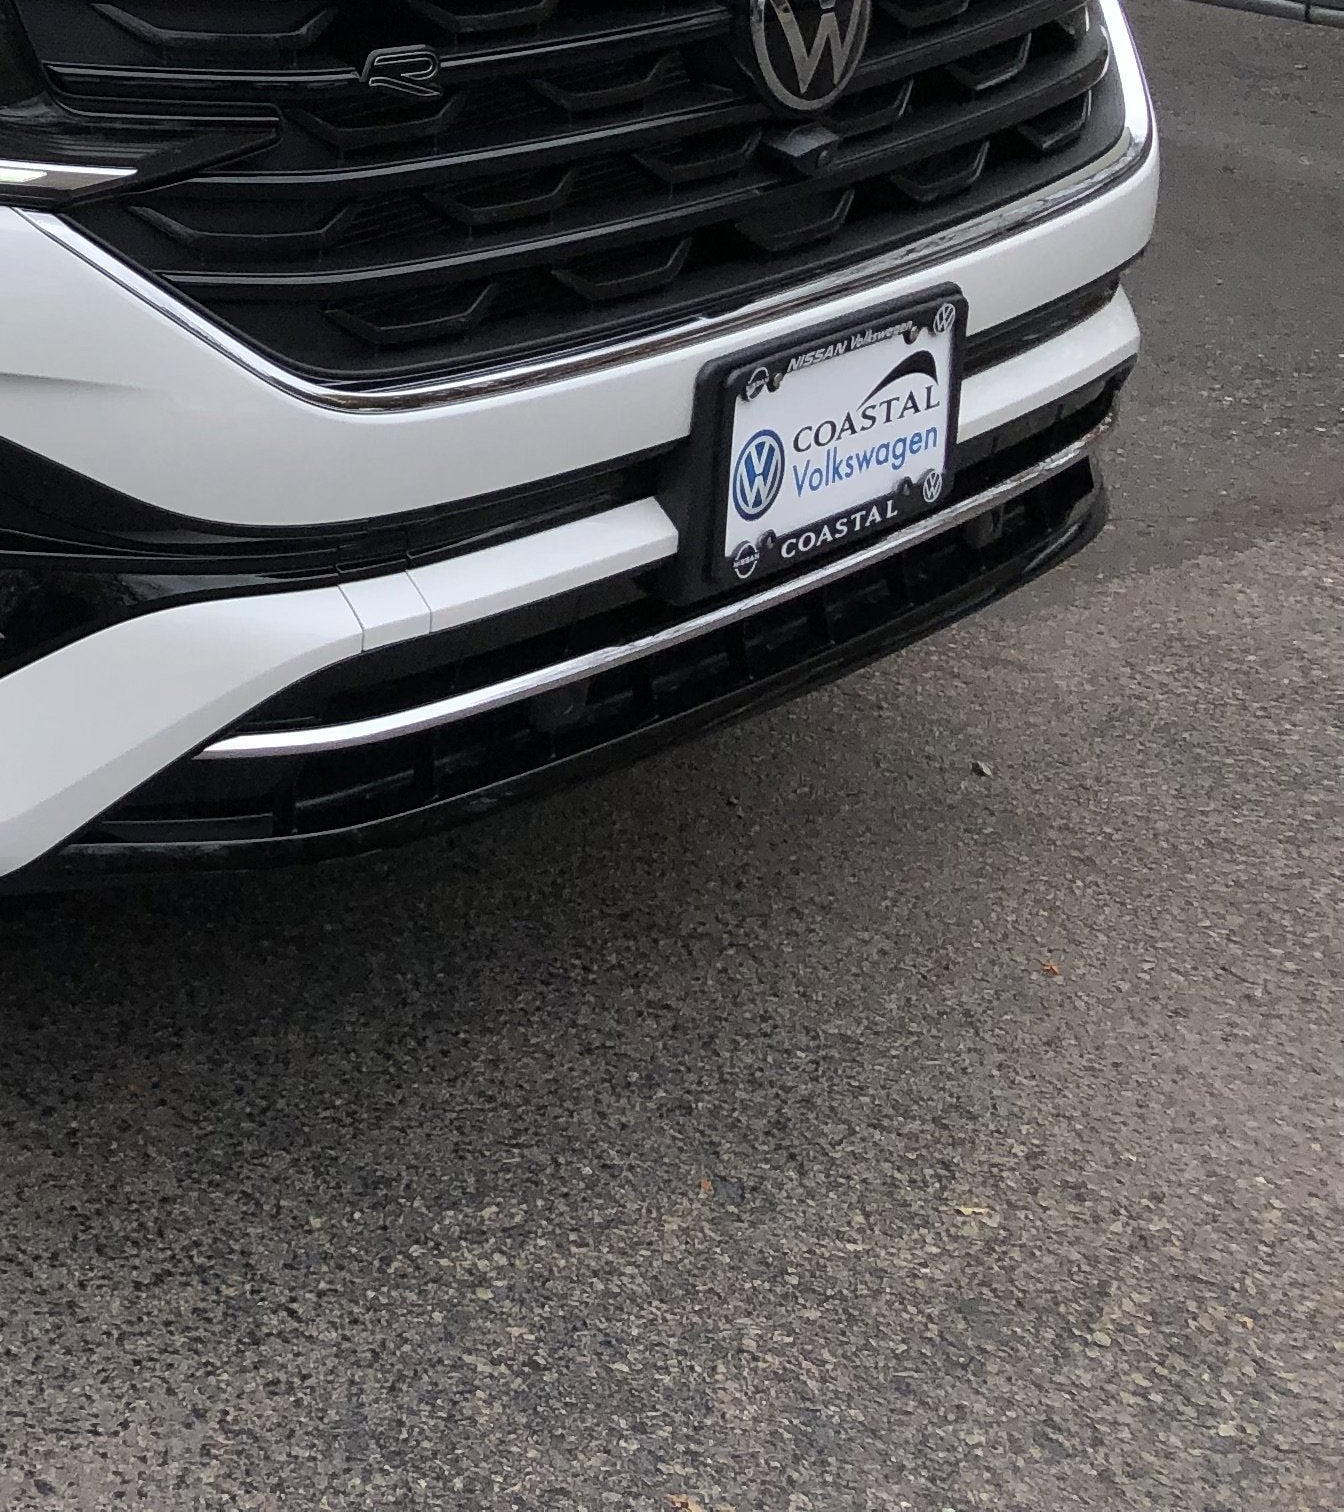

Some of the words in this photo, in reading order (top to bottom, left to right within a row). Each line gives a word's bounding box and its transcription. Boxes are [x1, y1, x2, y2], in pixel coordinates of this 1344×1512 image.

[787, 340, 847, 372] NISSAN
[850, 320, 914, 349] Volkswagen
[793, 385, 940, 453] COASTAL
[793, 426, 938, 497] Volkswagen
[781, 499, 898, 559] COASTAL
